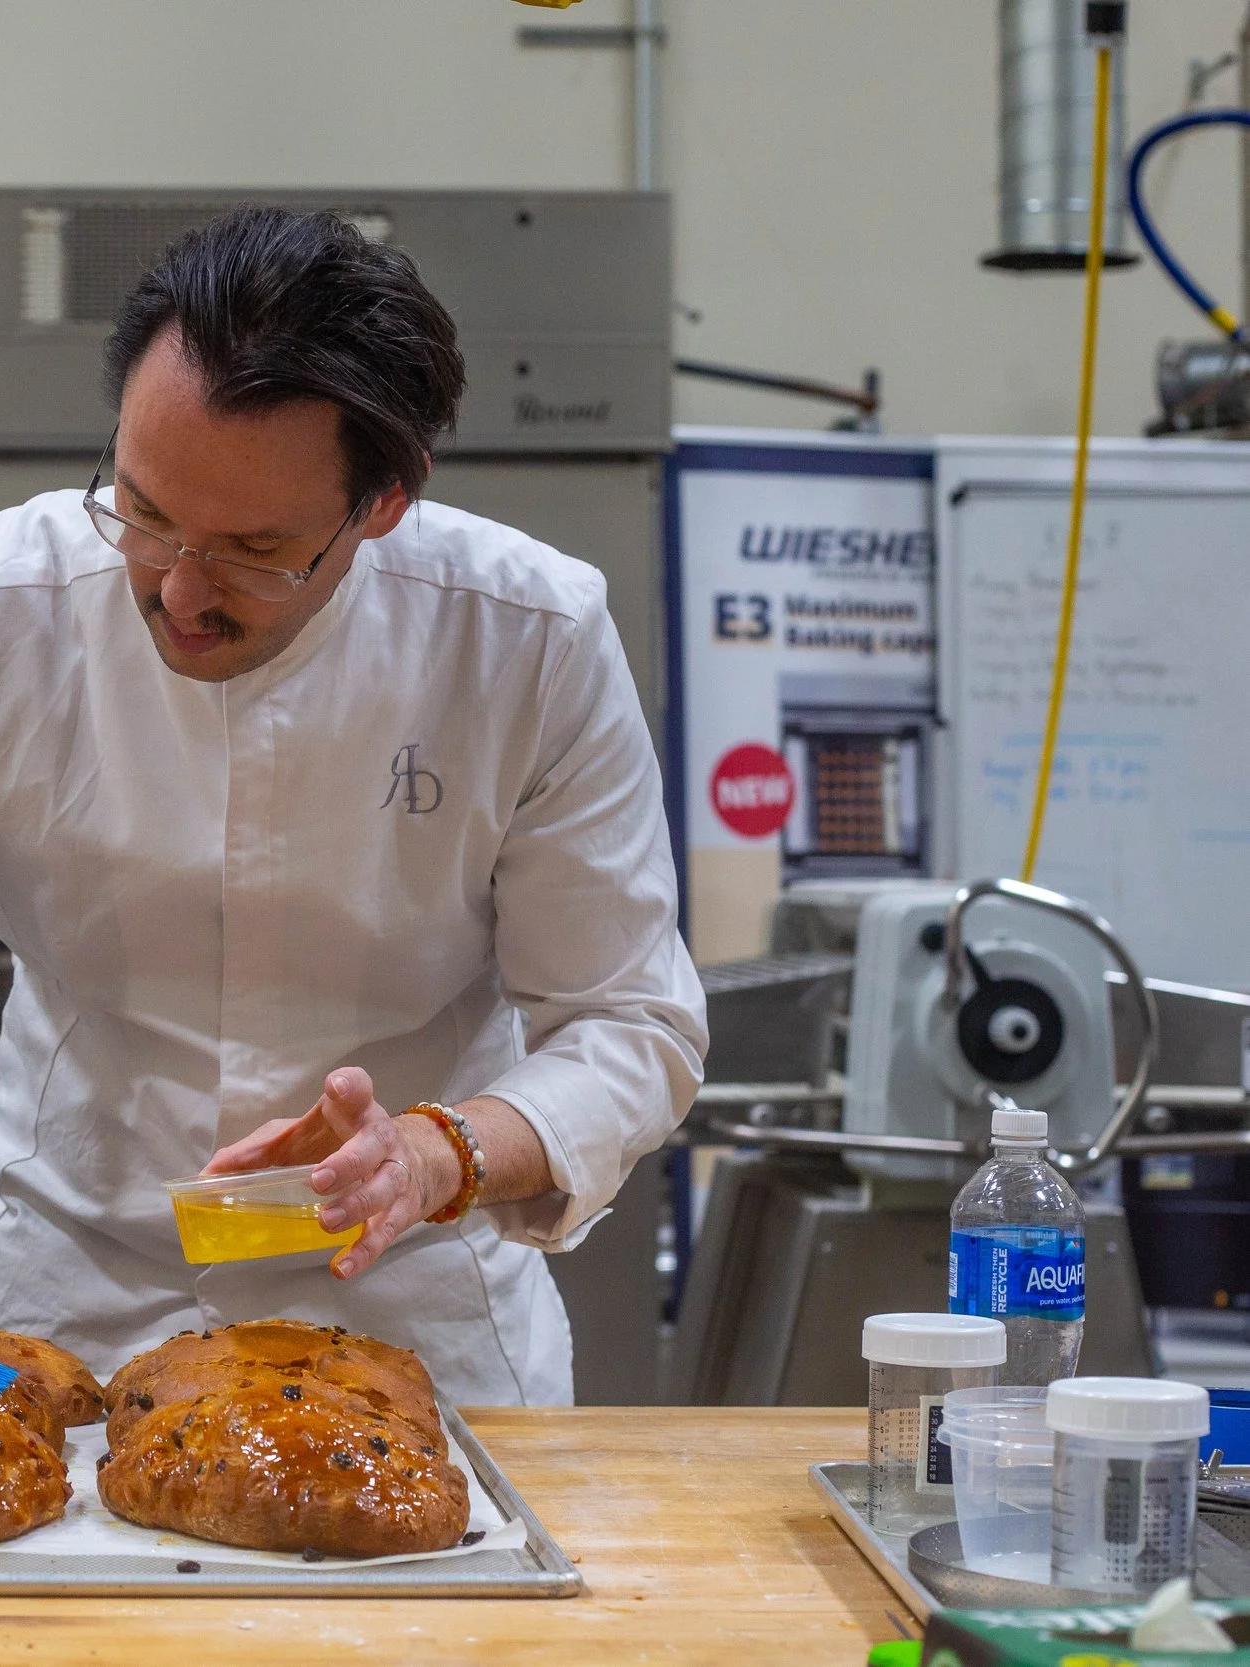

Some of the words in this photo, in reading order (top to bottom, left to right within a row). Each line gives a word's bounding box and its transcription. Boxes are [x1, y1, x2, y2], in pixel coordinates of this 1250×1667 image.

[714, 594, 771, 641] E3
[785, 594, 917, 619] Maximum
[785, 627, 873, 657] Baking
[717, 776, 788, 808] NEW
[998, 1248, 1008, 1313] RECYCLE
[1039, 1299, 1055, 1307] pure
